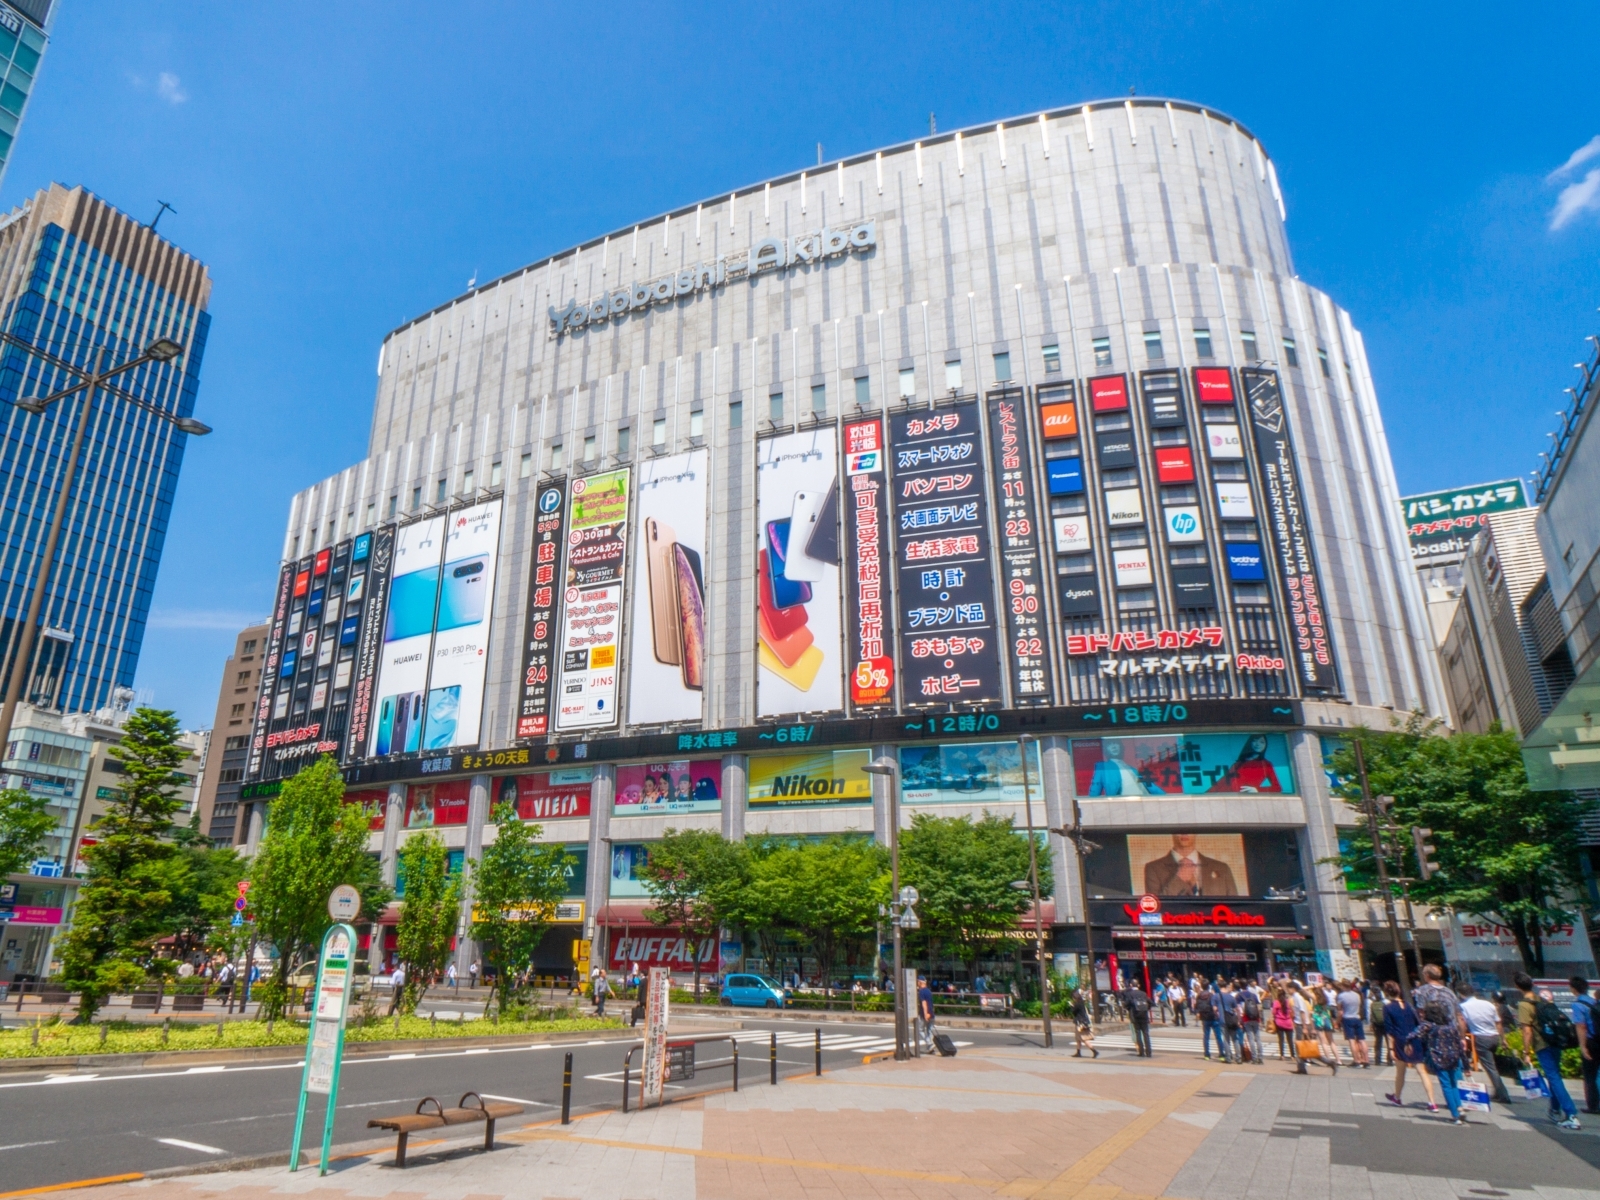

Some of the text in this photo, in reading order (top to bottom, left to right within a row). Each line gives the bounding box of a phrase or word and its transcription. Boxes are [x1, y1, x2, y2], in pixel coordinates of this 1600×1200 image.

[548, 221, 876, 333] Yodobashi-Akiba
[1095, 389, 1122, 397] docomo
[907, 413, 959, 436] カメラ
[1045, 414, 1072, 426] au
[850, 423, 876, 438] 欢迎
[999, 402, 1020, 470] レストラン街
[850, 438, 877, 452] 光临
[898, 443, 973, 468] スマートフォン
[1002, 471, 1022, 480] あさ
[1052, 471, 1079, 479] Panasonic
[903, 474, 973, 497] パソコン
[1003, 481, 1024, 498] 11
[468, 512, 493, 523] HUAWEI
[901, 502, 978, 529] 大画面テレビ
[1006, 509, 1027, 519] よる
[1111, 511, 1140, 520] Nikon
[537, 520, 560, 533] 520
[1005, 519, 1031, 537] 23
[1175, 514, 1194, 534] hp
[1406, 515, 1477, 536] チメディア
[543, 531, 552, 541] 台
[584, 528, 612, 541] 30店舗
[569, 542, 624, 559] レストラン&カフェ
[906, 535, 979, 560] 生活家電
[534, 541, 555, 608] 駐車場
[586, 569, 614, 579] GOURMET
[855, 490, 883, 660] 可享受免税后再折扣
[922, 567, 965, 589] 時計
[1011, 567, 1032, 577] あさ
[1010, 579, 1036, 595] 9時
[1065, 589, 1094, 599] dyson
[580, 590, 608, 603] 15店舗
[1012, 596, 1038, 614] 30
[533, 611, 550, 621] あさ
[570, 615, 614, 630] ファッション
[908, 603, 986, 627] ブランド品
[533, 621, 547, 640] 8
[1017, 628, 1038, 637] よる
[568, 632, 614, 647] ミュージック
[911, 636, 985, 658] おもちゃ
[1016, 638, 1042, 656] 22
[1067, 627, 1223, 654] ヨドバシカメラ
[437, 648, 449, 658] P30
[452, 644, 476, 655] P30 Pro
[393, 653, 422, 666] HUAWEI
[530, 655, 546, 666] よる
[1099, 653, 1285, 676] マルチメディア Akiba
[526, 665, 548, 685] 24
[563, 677, 586, 685] YURINDO
[856, 661, 889, 688] 5%
[1019, 669, 1044, 681] 年中
[921, 674, 980, 695] ホビー
[1020, 681, 1045, 693] 無休
[266, 723, 321, 748] ヨドバシカメラ
[274, 741, 338, 760] マルチメディア Akiba
[421, 757, 452, 773] 秋葉原
[462, 750, 530, 769] きょうの天気
[574, 743, 588, 759] 晴
[678, 731, 738, 750] 降水確率
[771, 774, 846, 797] Nikon
[439, 797, 466, 808] Y!mobile
[1123, 905, 1266, 927] Ybashi-Akiba
[1026, 931, 1048, 939] CAE
